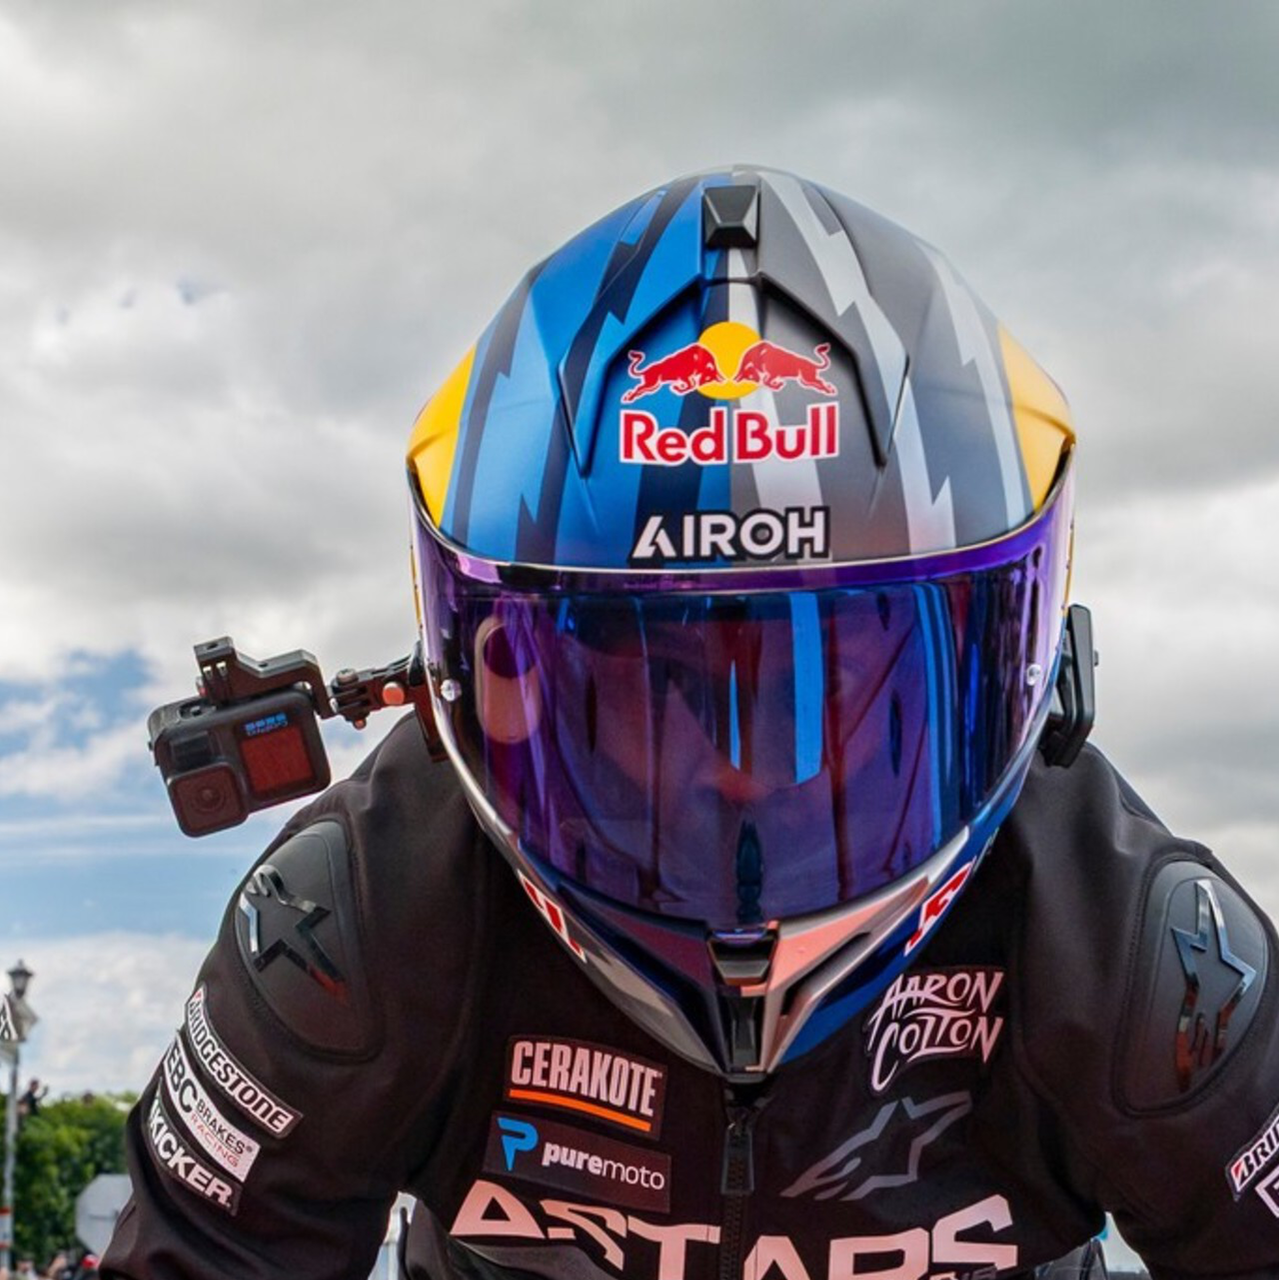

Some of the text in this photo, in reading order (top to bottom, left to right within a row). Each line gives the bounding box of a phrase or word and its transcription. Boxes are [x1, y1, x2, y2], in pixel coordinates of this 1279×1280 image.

[620, 401, 839, 465] Red Bull
[632, 510, 825, 559] AIROH
[868, 971, 1005, 1051] AARON
[871, 1007, 1005, 1092] COLTON
[167, 1044, 246, 1155] EBC BRAKES
[186, 999, 292, 1131] BRIDGESTONE
[511, 1040, 663, 1117] CERAKOTE
[149, 1114, 233, 1208] KICKER
[541, 1141, 666, 1191] puremoto
